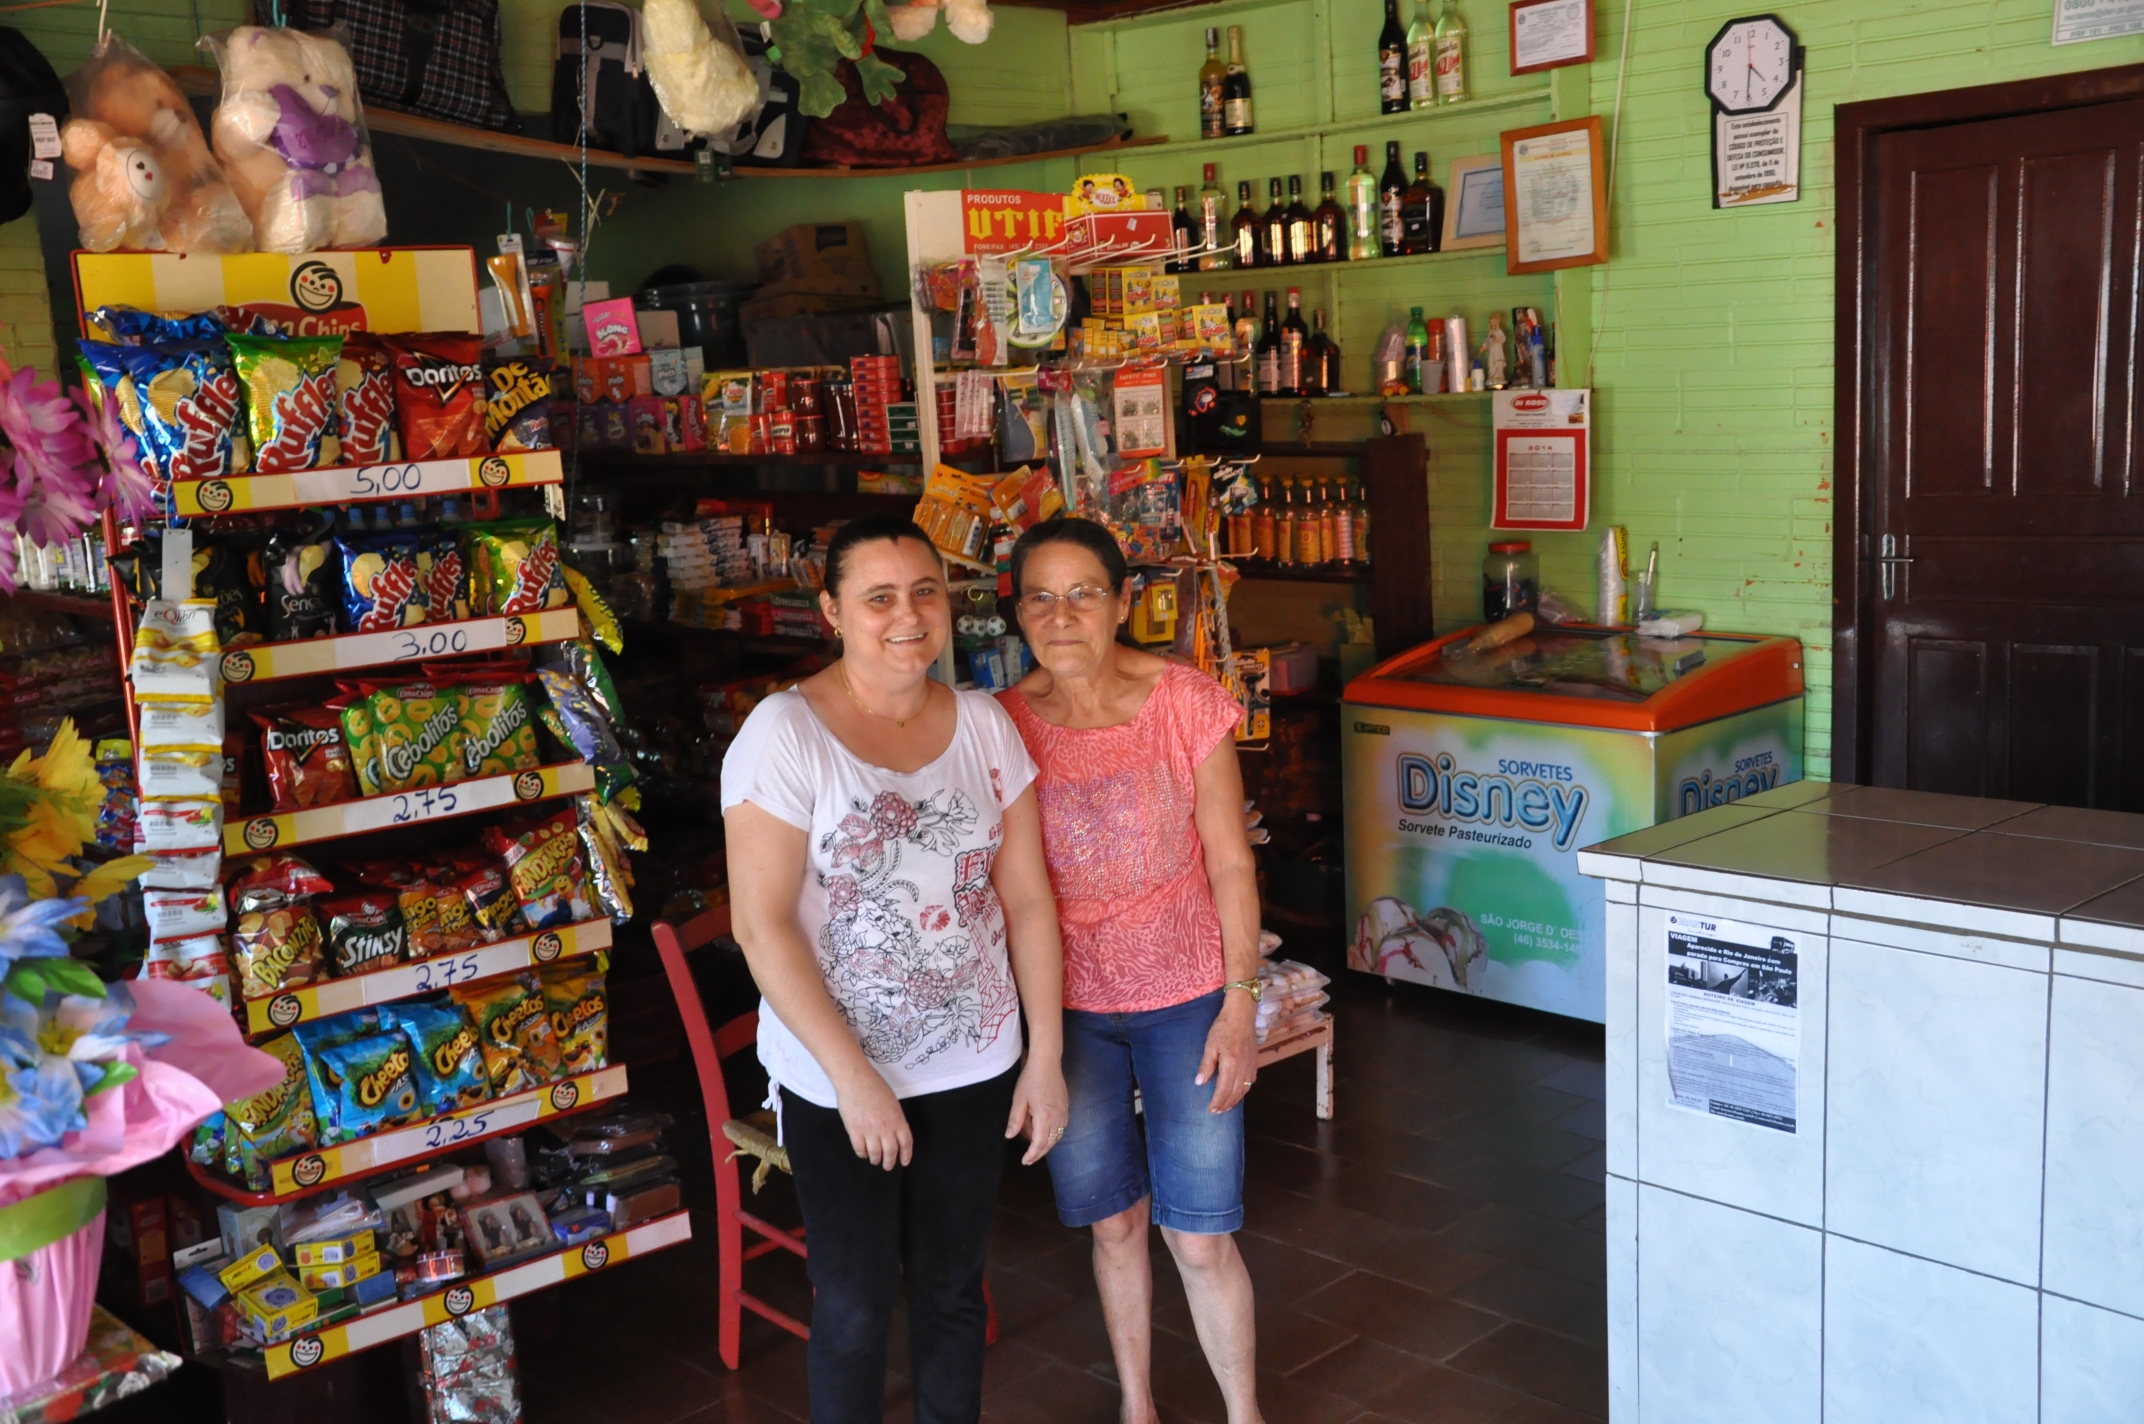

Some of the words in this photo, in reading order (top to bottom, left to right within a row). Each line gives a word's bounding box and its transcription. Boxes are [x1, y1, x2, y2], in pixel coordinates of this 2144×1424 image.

[1734, 36, 1741, 44] 11
[1747, 29, 1756, 39] 12
[1765, 32, 1769, 40] 1
[1722, 49, 1731, 58] 10
[1774, 42, 1780, 51] 2
[1718, 65, 1723, 74] 9
[1778, 57, 1784, 66] 3
[1721, 81, 1727, 89] 8
[1733, 90, 1739, 99] 7
[1762, 87, 1767, 96] 5
[967, 194, 1021, 205] PRODUTOS
[405, 364, 482, 387] Doritos
[493, 361, 529, 392] De
[1119, 373, 1139, 381] SAFETY
[485, 371, 550, 439] Montã
[268, 728, 340, 750] Doritos
[388, 703, 459, 781] Cebolitos
[464, 698, 527, 777] ebolitos
[1498, 758, 1573, 782] SORVETES
[1735, 751, 1773, 773] SORVETES
[393, 783, 458, 823] 2,75
[1398, 753, 1588, 850] Disney
[1398, 819, 1445, 837] Sorvete
[1448, 826, 1532, 849] Pasteurizado
[1480, 913, 1503, 927] SÃO
[1505, 919, 1543, 934] JORGE
[1514, 933, 1533, 948] (46)
[1670, 932, 1698, 943] VIAGEM
[1686, 943, 1717, 953] Aparecida
[1723, 947, 1733, 956] Rio
[1743, 953, 1766, 963] Janeiro
[1767, 957, 1781, 965] com
[1686, 951, 1708, 960] parada
[1723, 957, 1750, 967] Compras
[1761, 963, 1774, 971] São
[1774, 966, 1792, 975] Paulo
[416, 954, 478, 991] 2,75
[1703, 992, 1726, 1001] ROTEIRO
[1735, 998, 1756, 1006] VIAGEM
[426, 1110, 495, 1147] 2,25
